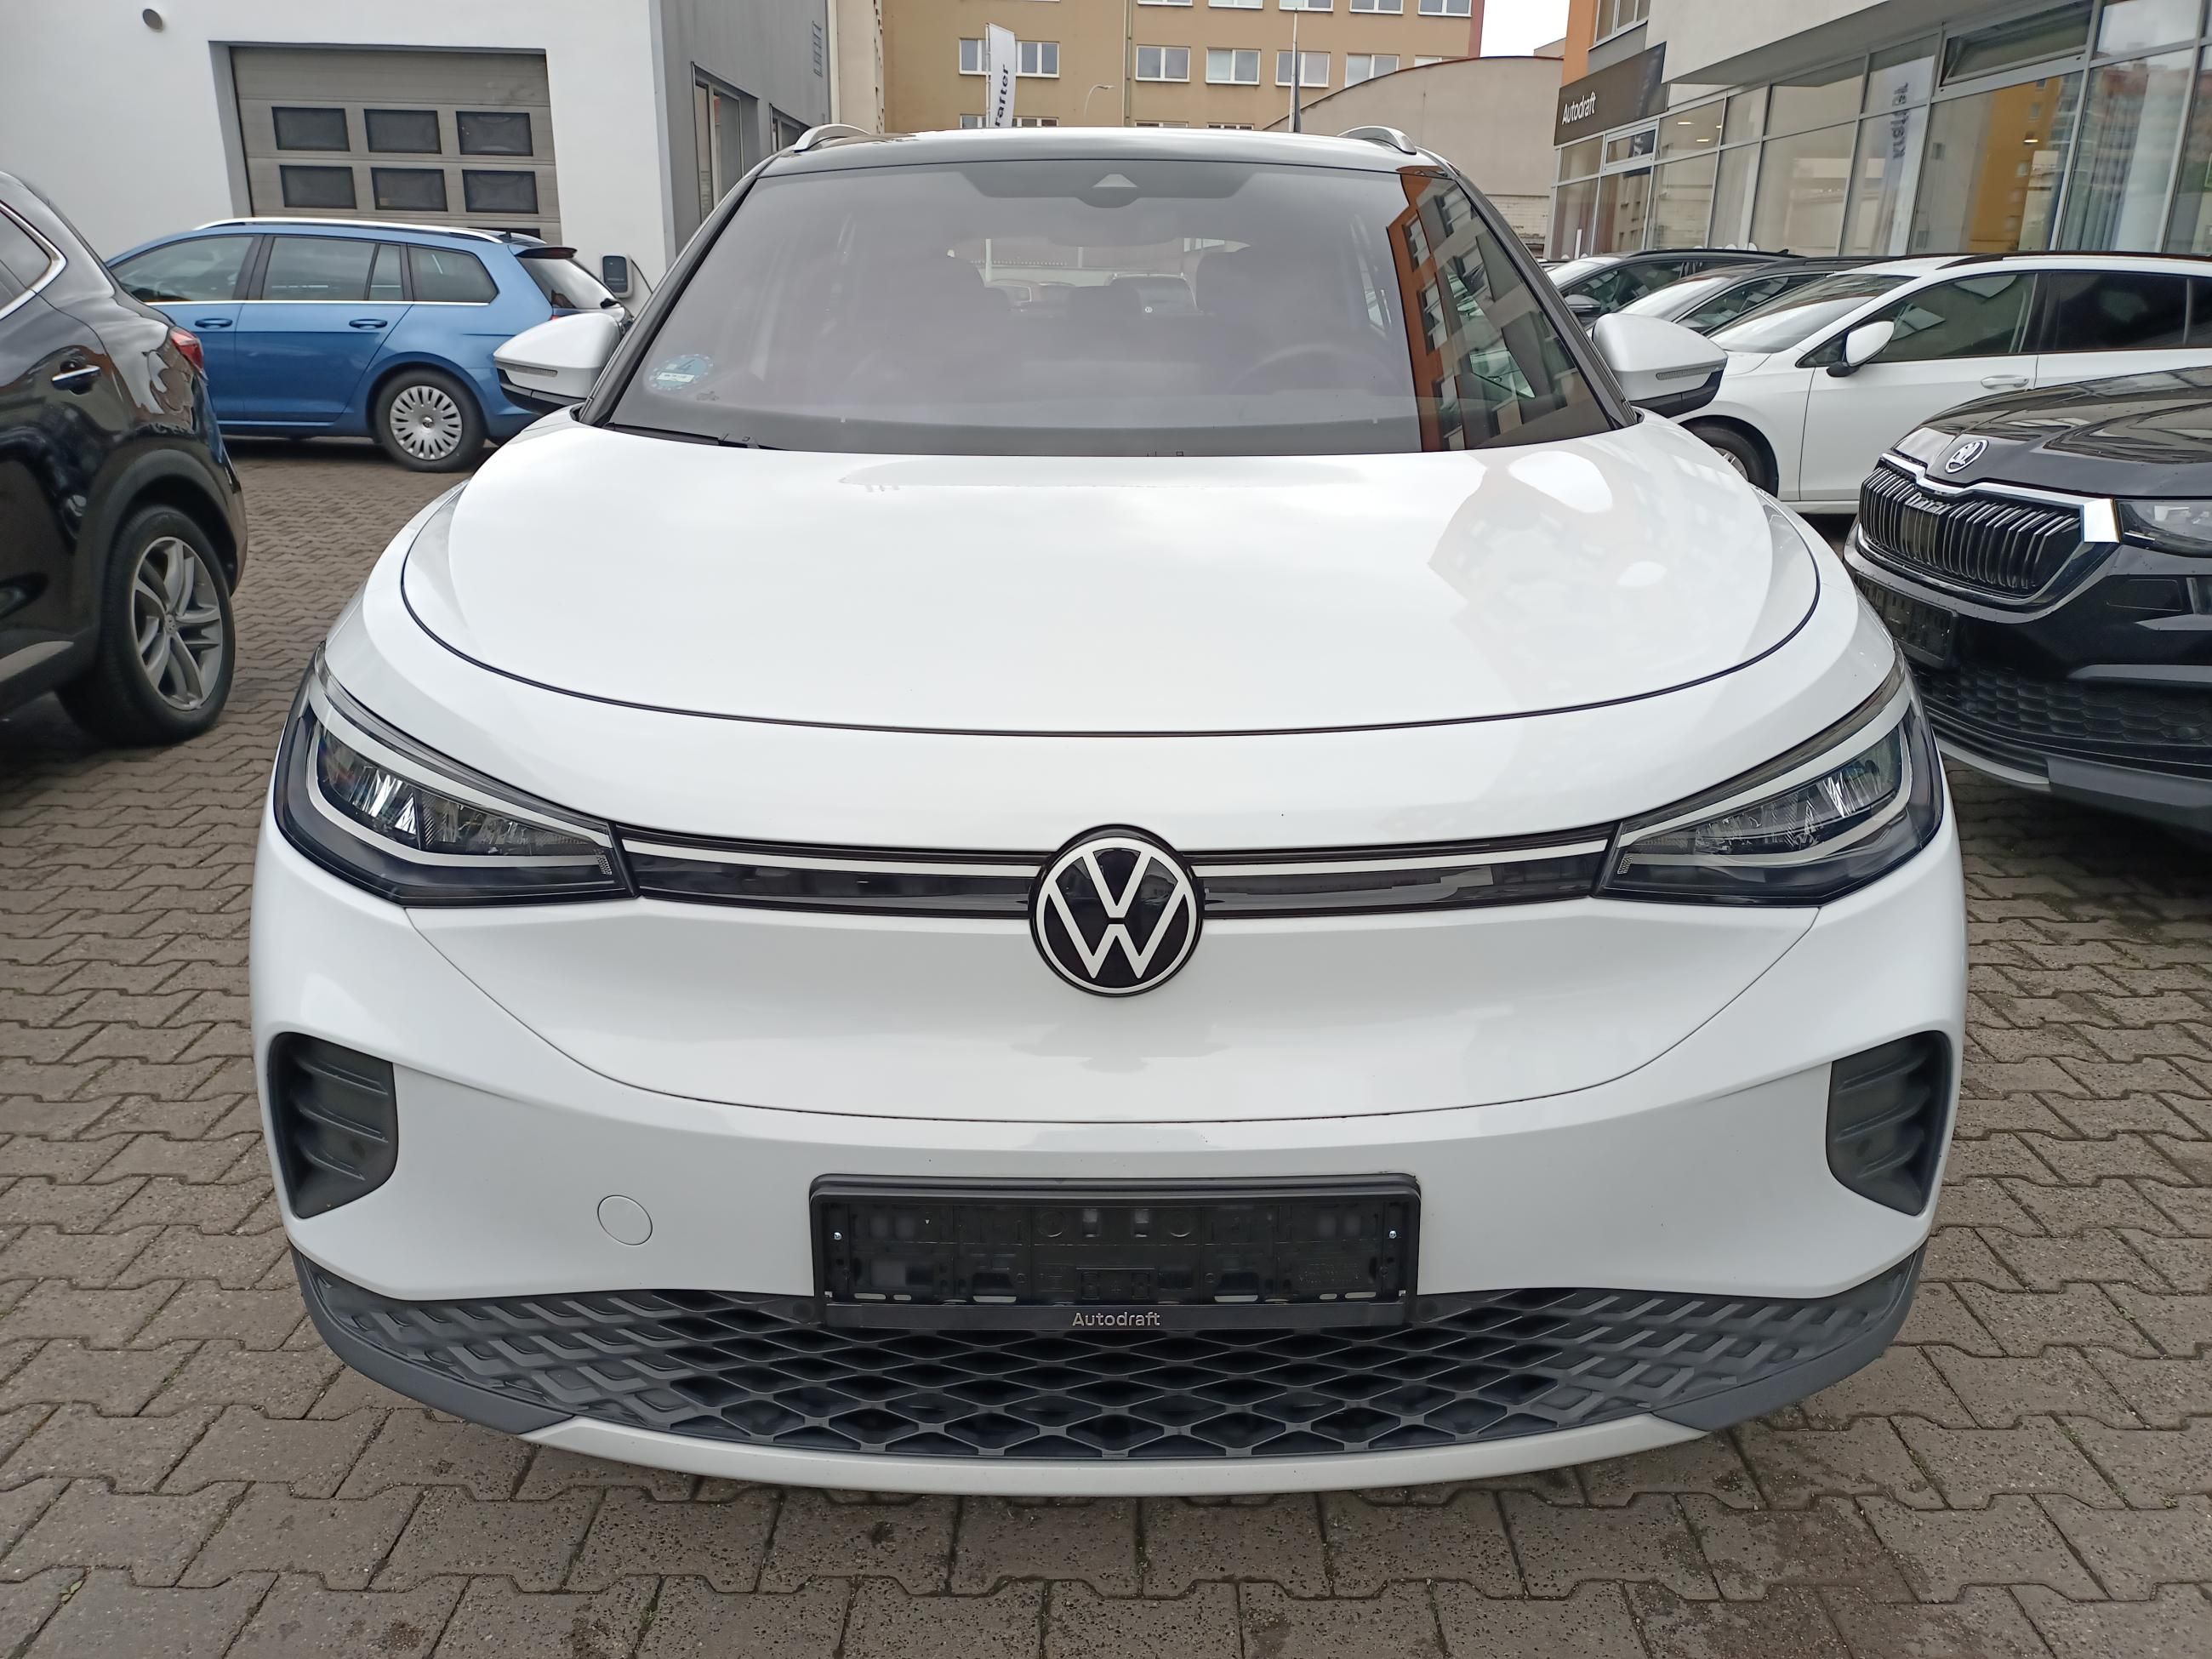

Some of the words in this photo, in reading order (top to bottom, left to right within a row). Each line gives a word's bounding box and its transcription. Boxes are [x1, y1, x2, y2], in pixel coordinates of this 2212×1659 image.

[994, 64, 1009, 127] rafter
[1561, 91, 1596, 125] Autodraft
[1041, 841, 1192, 980] VW
[1072, 1311, 1160, 1326] Autodraft
